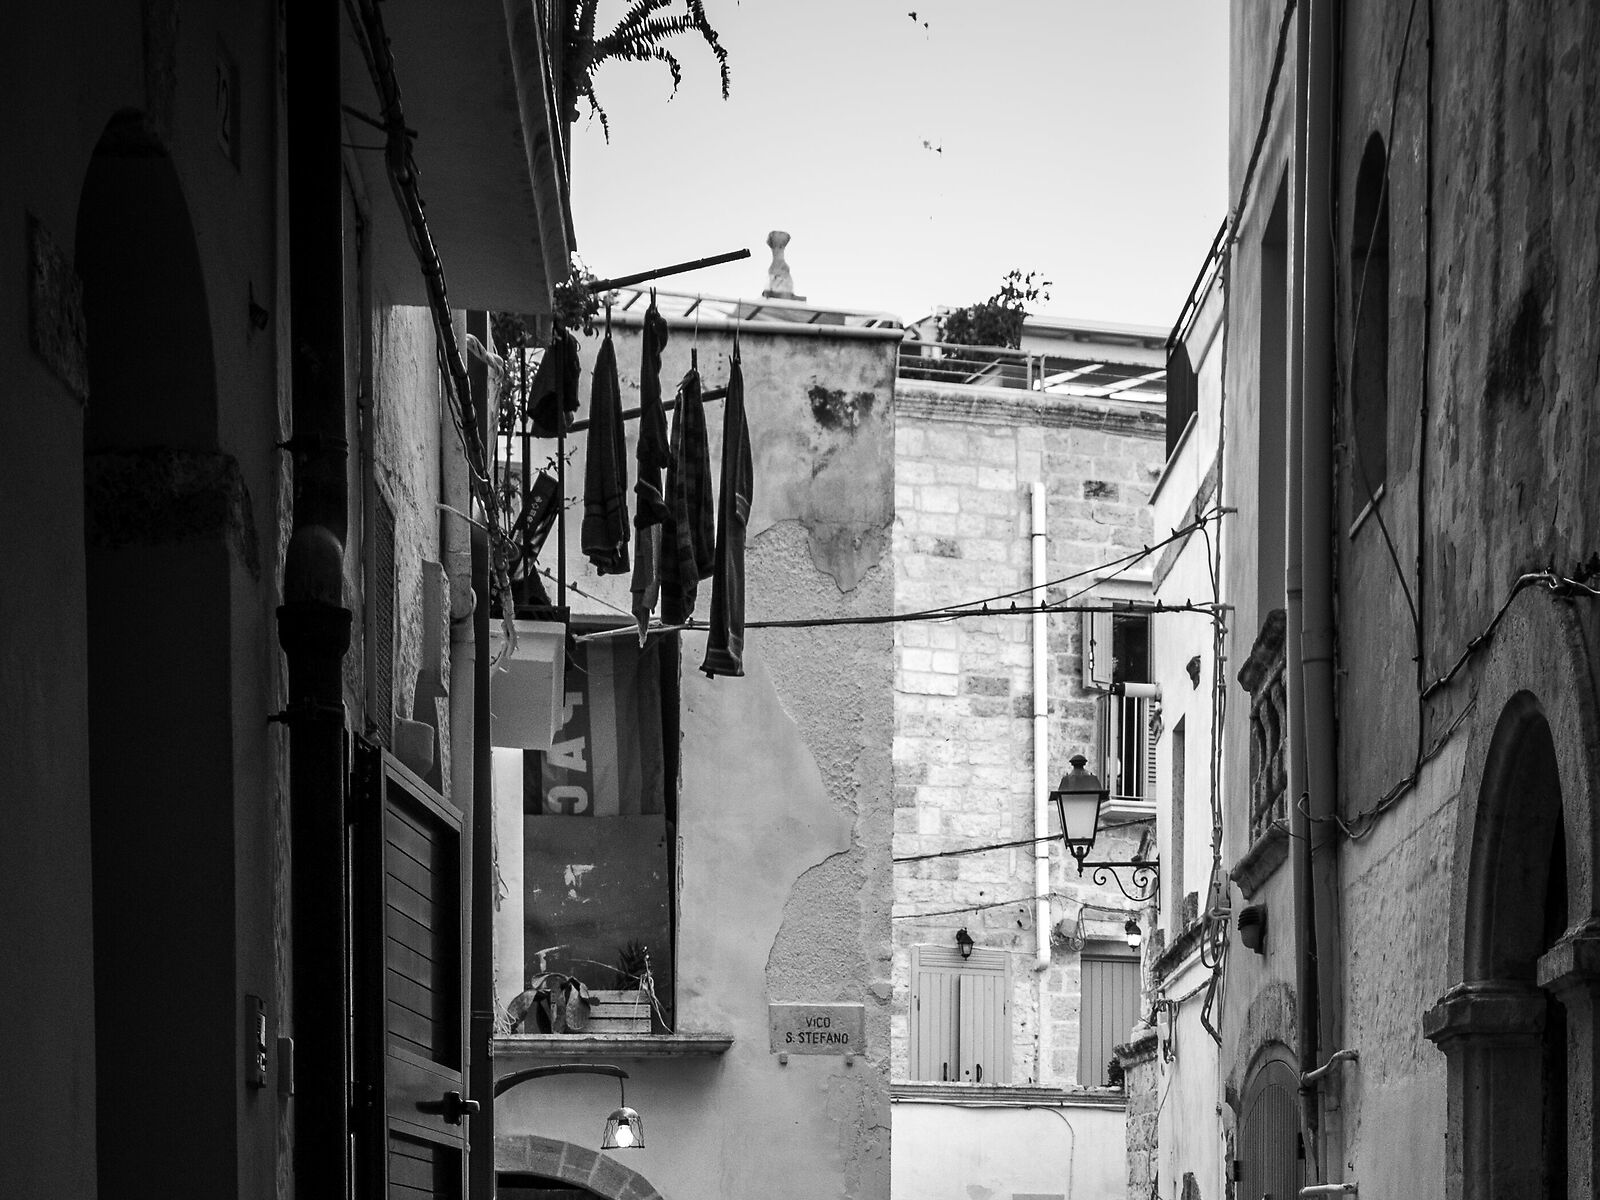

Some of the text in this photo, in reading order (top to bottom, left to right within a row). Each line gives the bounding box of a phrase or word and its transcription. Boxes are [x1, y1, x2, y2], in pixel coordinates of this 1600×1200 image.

[805, 1016, 831, 1028] VICO
[785, 1031, 849, 1044] S. STEFANO
